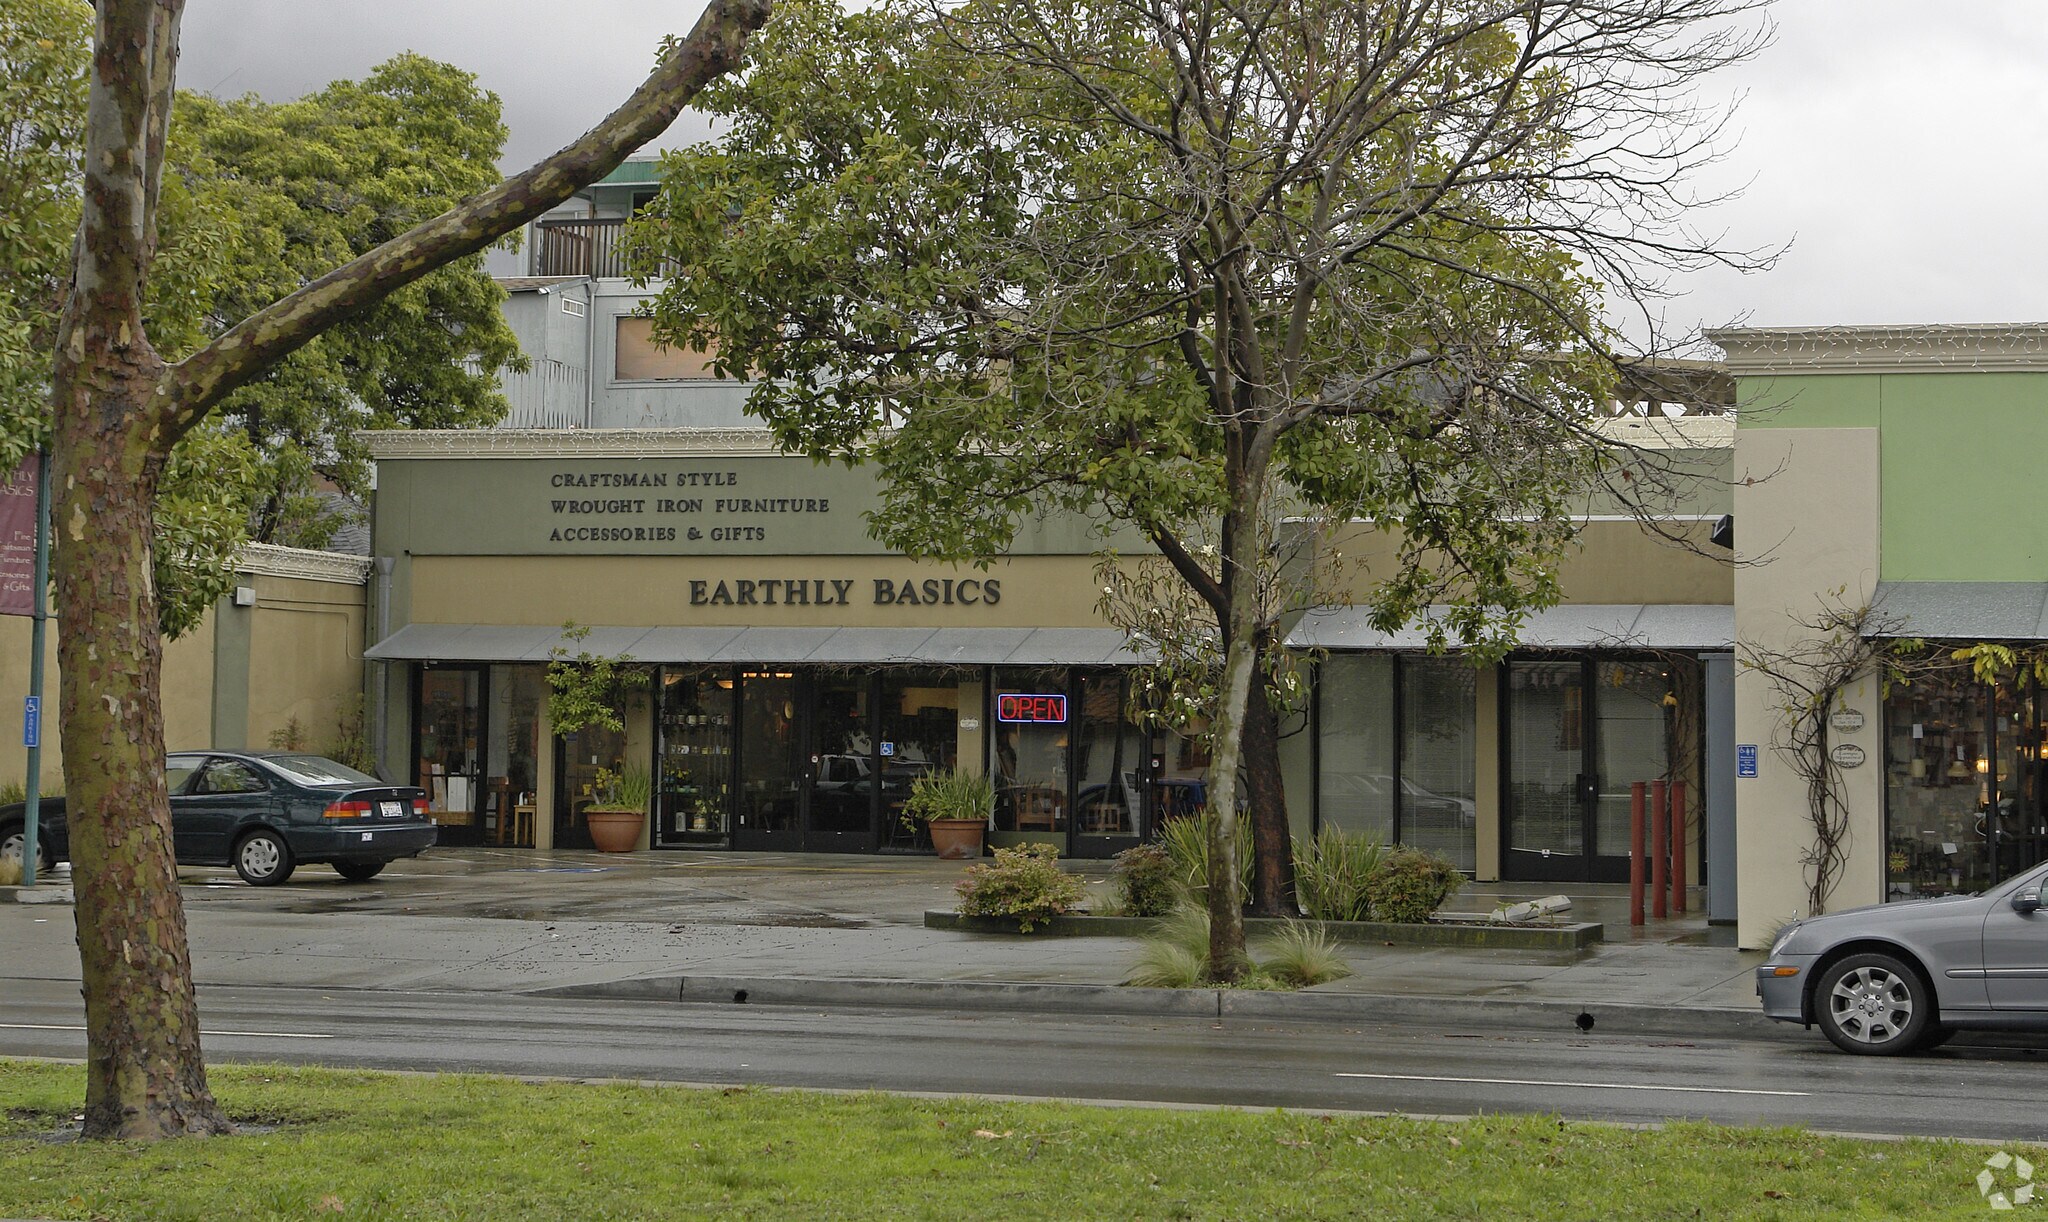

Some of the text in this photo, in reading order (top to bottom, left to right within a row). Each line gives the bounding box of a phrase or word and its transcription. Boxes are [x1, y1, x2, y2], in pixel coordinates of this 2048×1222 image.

[551, 472, 738, 488] CRAFTSMAN STYLE
[551, 498, 830, 514] WROUGHT IRON FURNITURE
[549, 526, 766, 541] ACCESSORIES & GIFTS
[688, 579, 1001, 606] EARTHLY BASICS
[1000, 696, 1064, 721] OPEN
